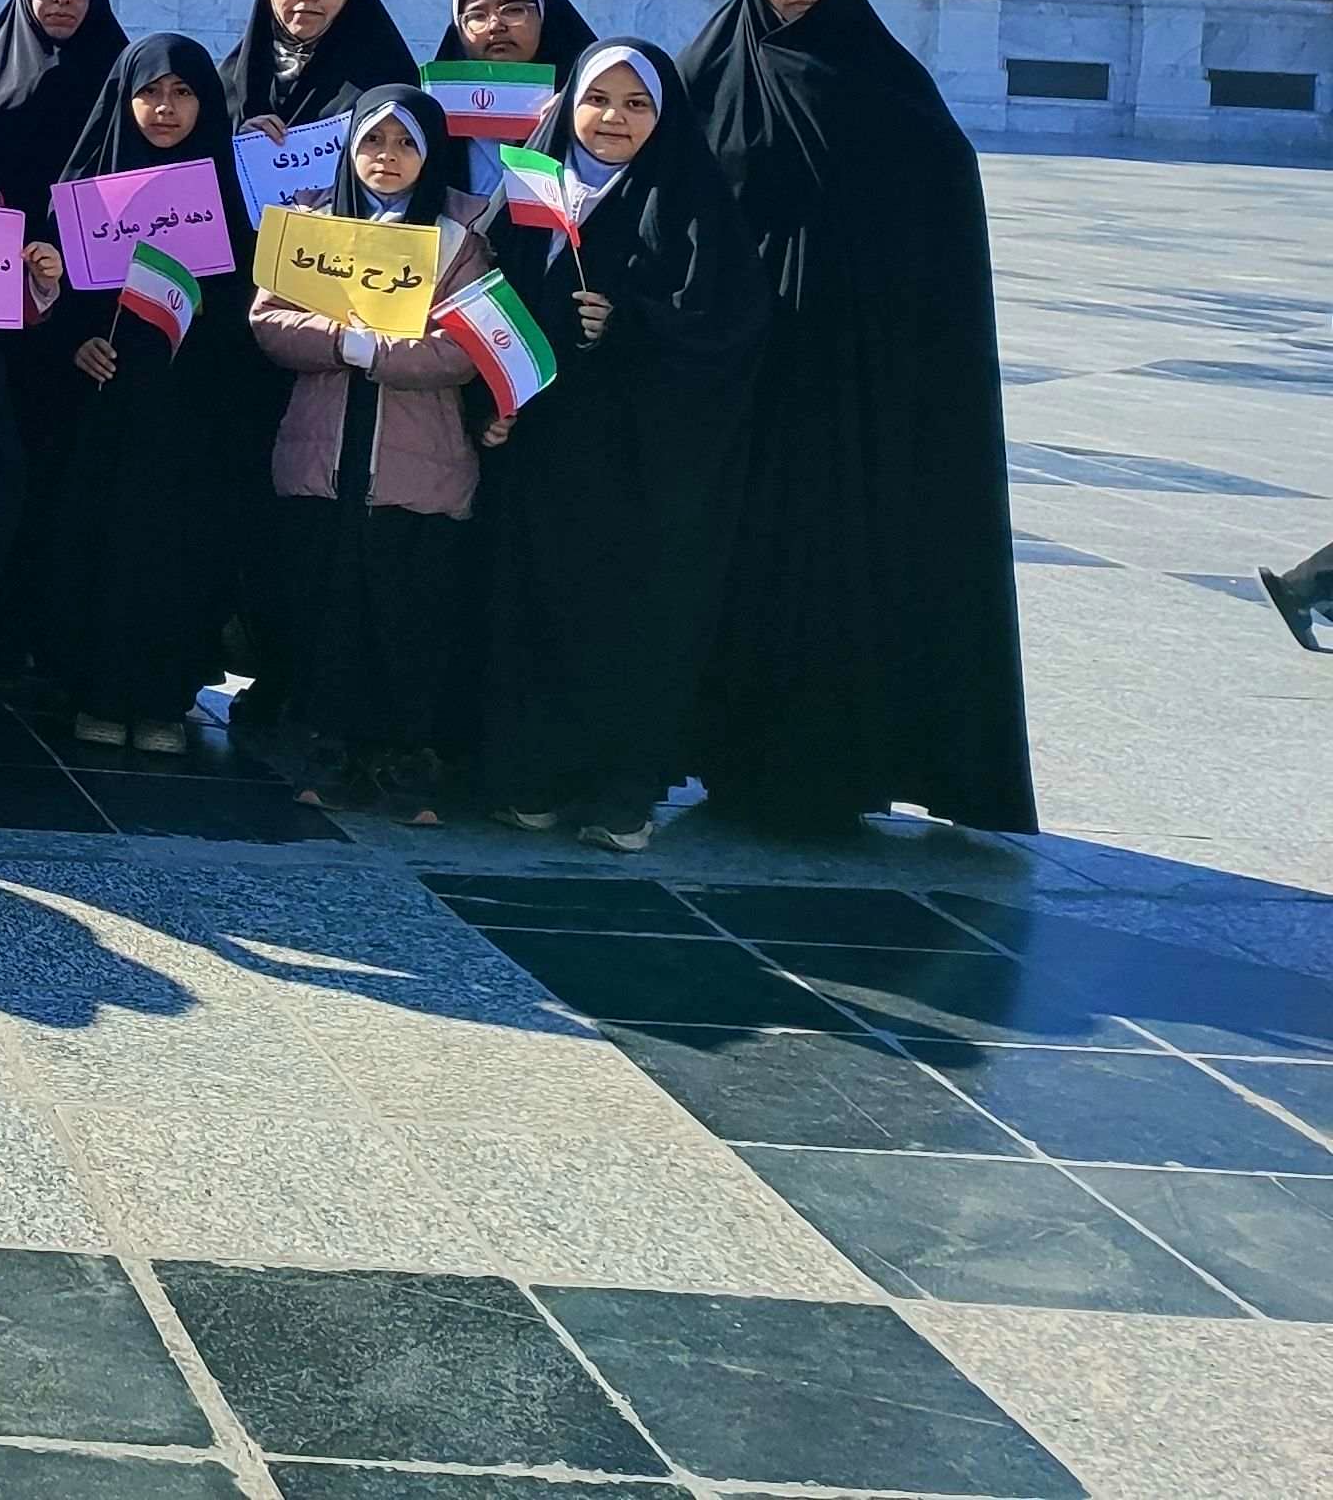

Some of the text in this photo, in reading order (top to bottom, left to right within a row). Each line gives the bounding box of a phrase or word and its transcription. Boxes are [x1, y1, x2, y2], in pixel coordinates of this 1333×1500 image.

[273, 135, 342, 169] اده روی
[92, 206, 213, 242] دهه فجر مبارک
[289, 247, 423, 294] طرح نشاط
